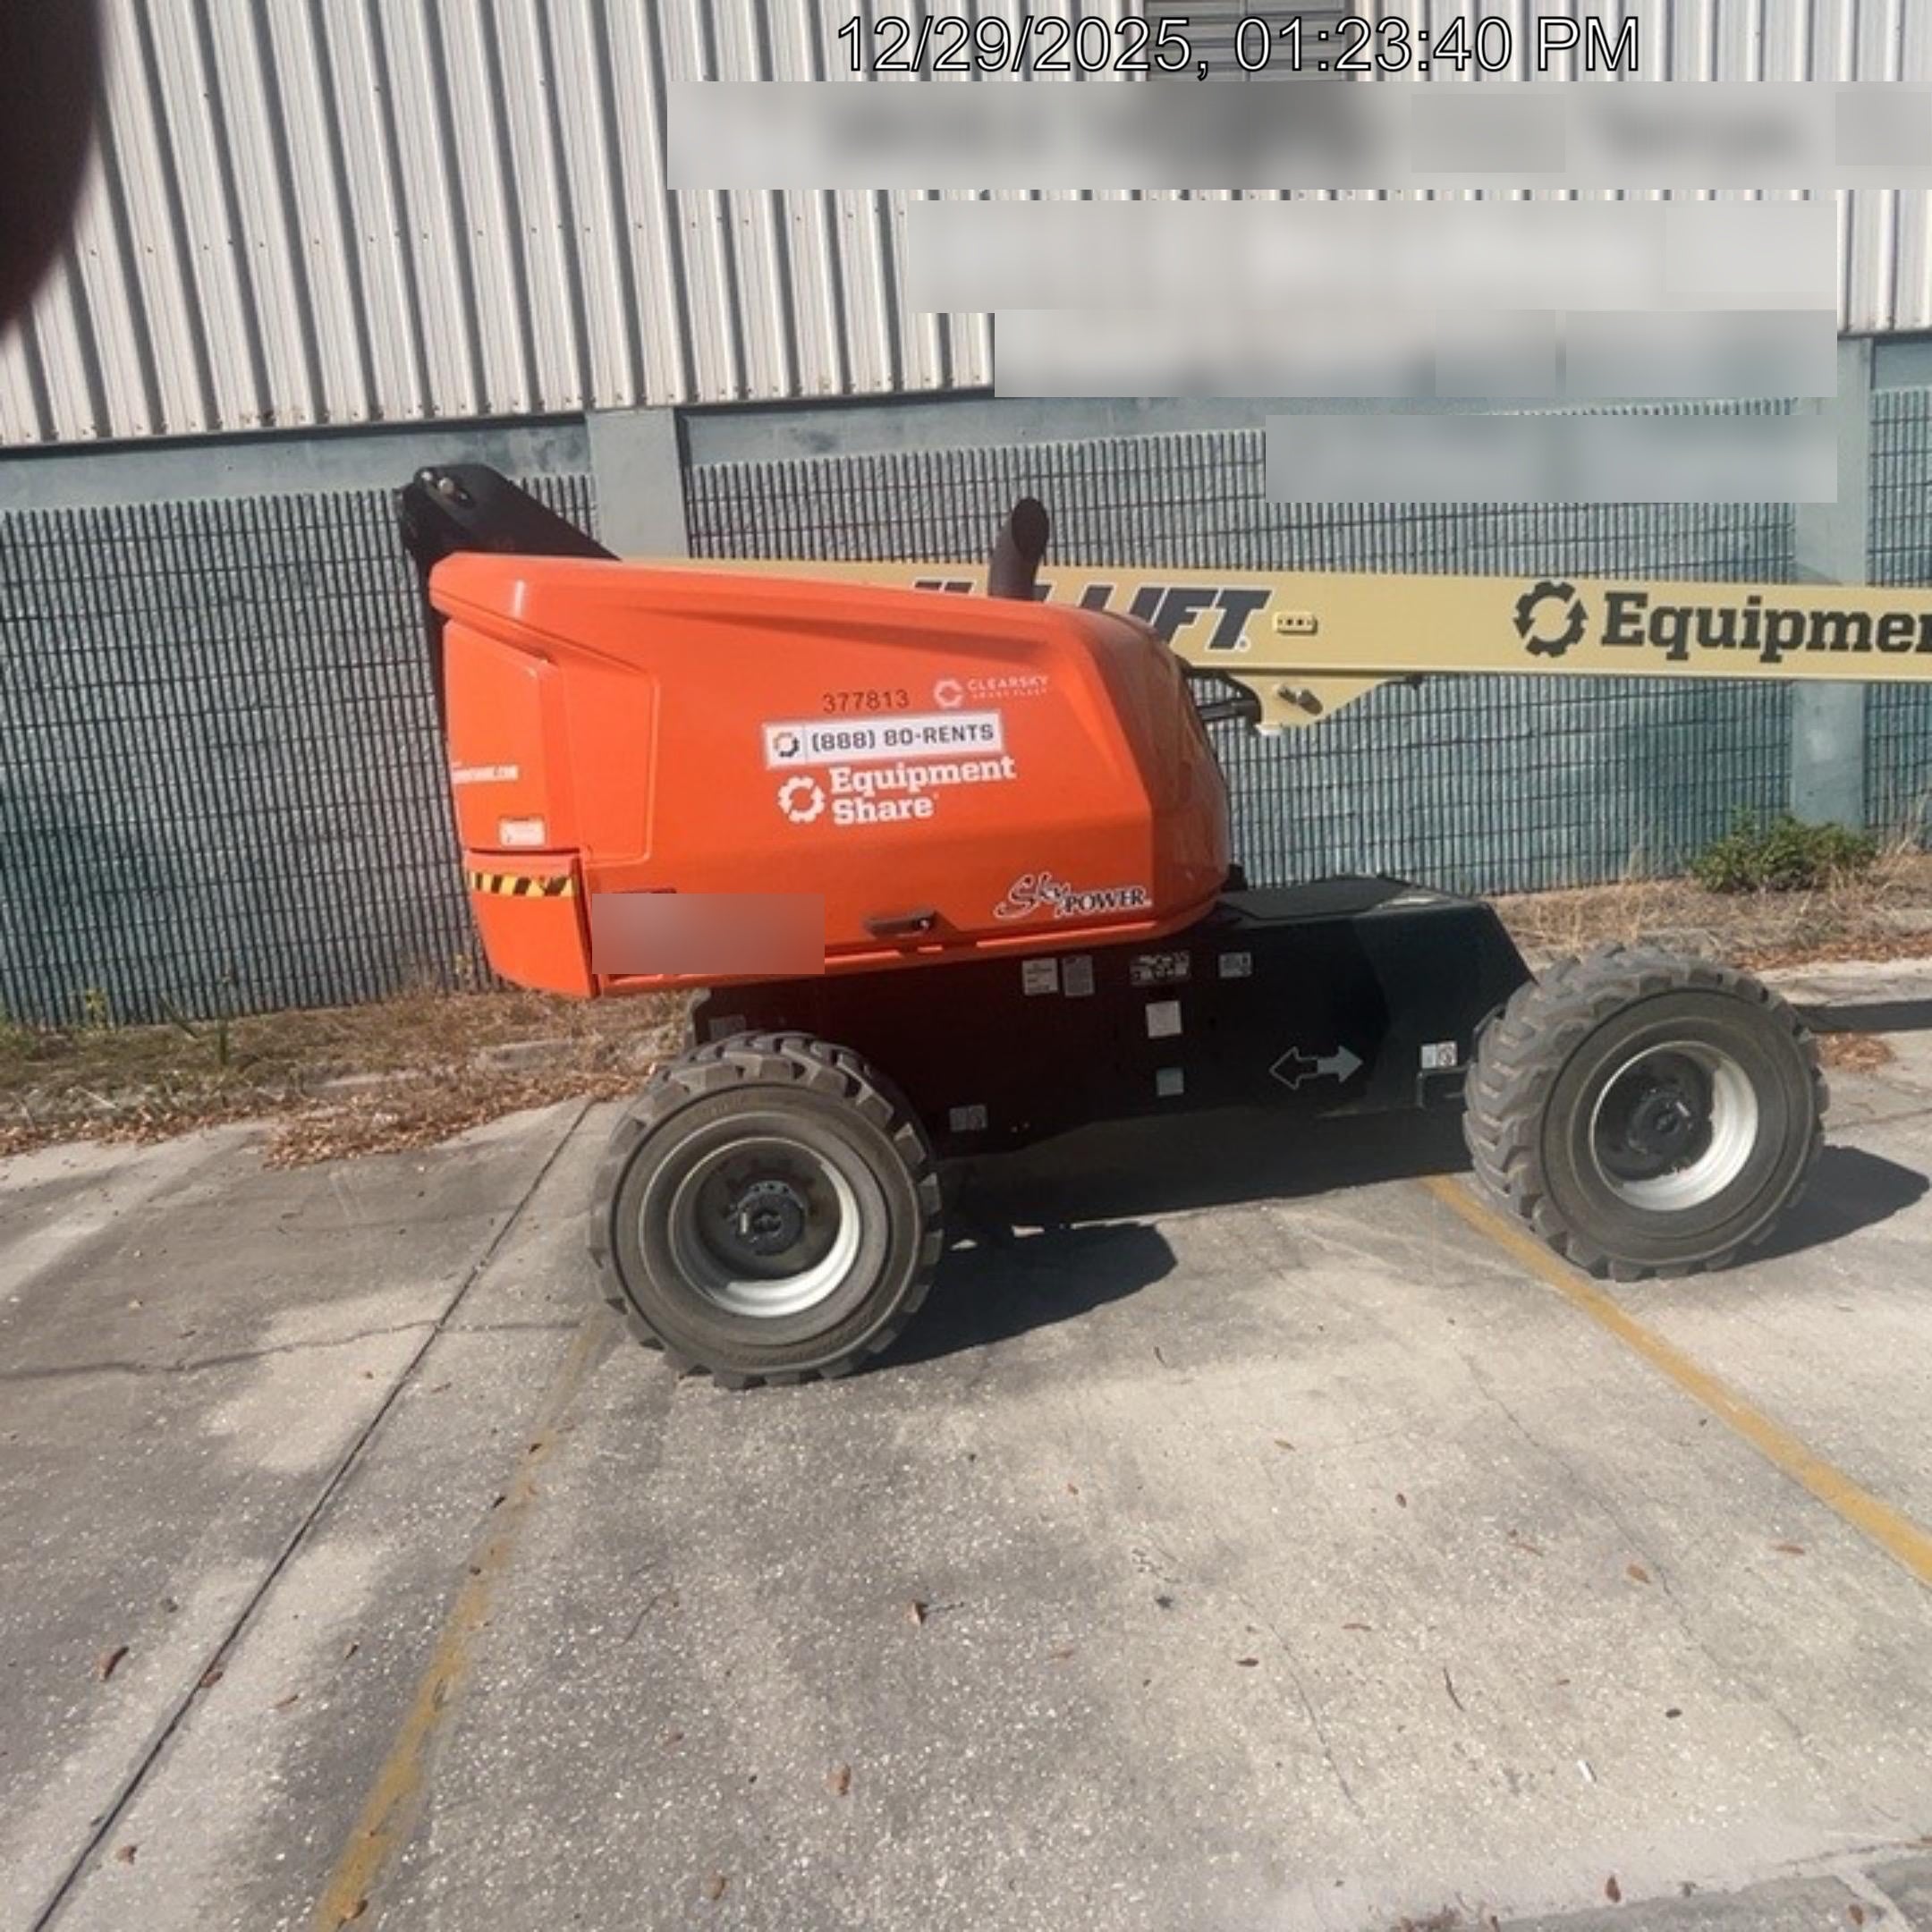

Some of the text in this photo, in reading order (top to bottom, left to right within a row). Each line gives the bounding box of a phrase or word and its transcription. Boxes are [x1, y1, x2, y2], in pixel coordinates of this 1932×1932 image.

[822, 688, 911, 715] 377813
[811, 729, 876, 752] (888)
[828, 755, 1017, 797] Equipment
[833, 794, 934, 826] Share
